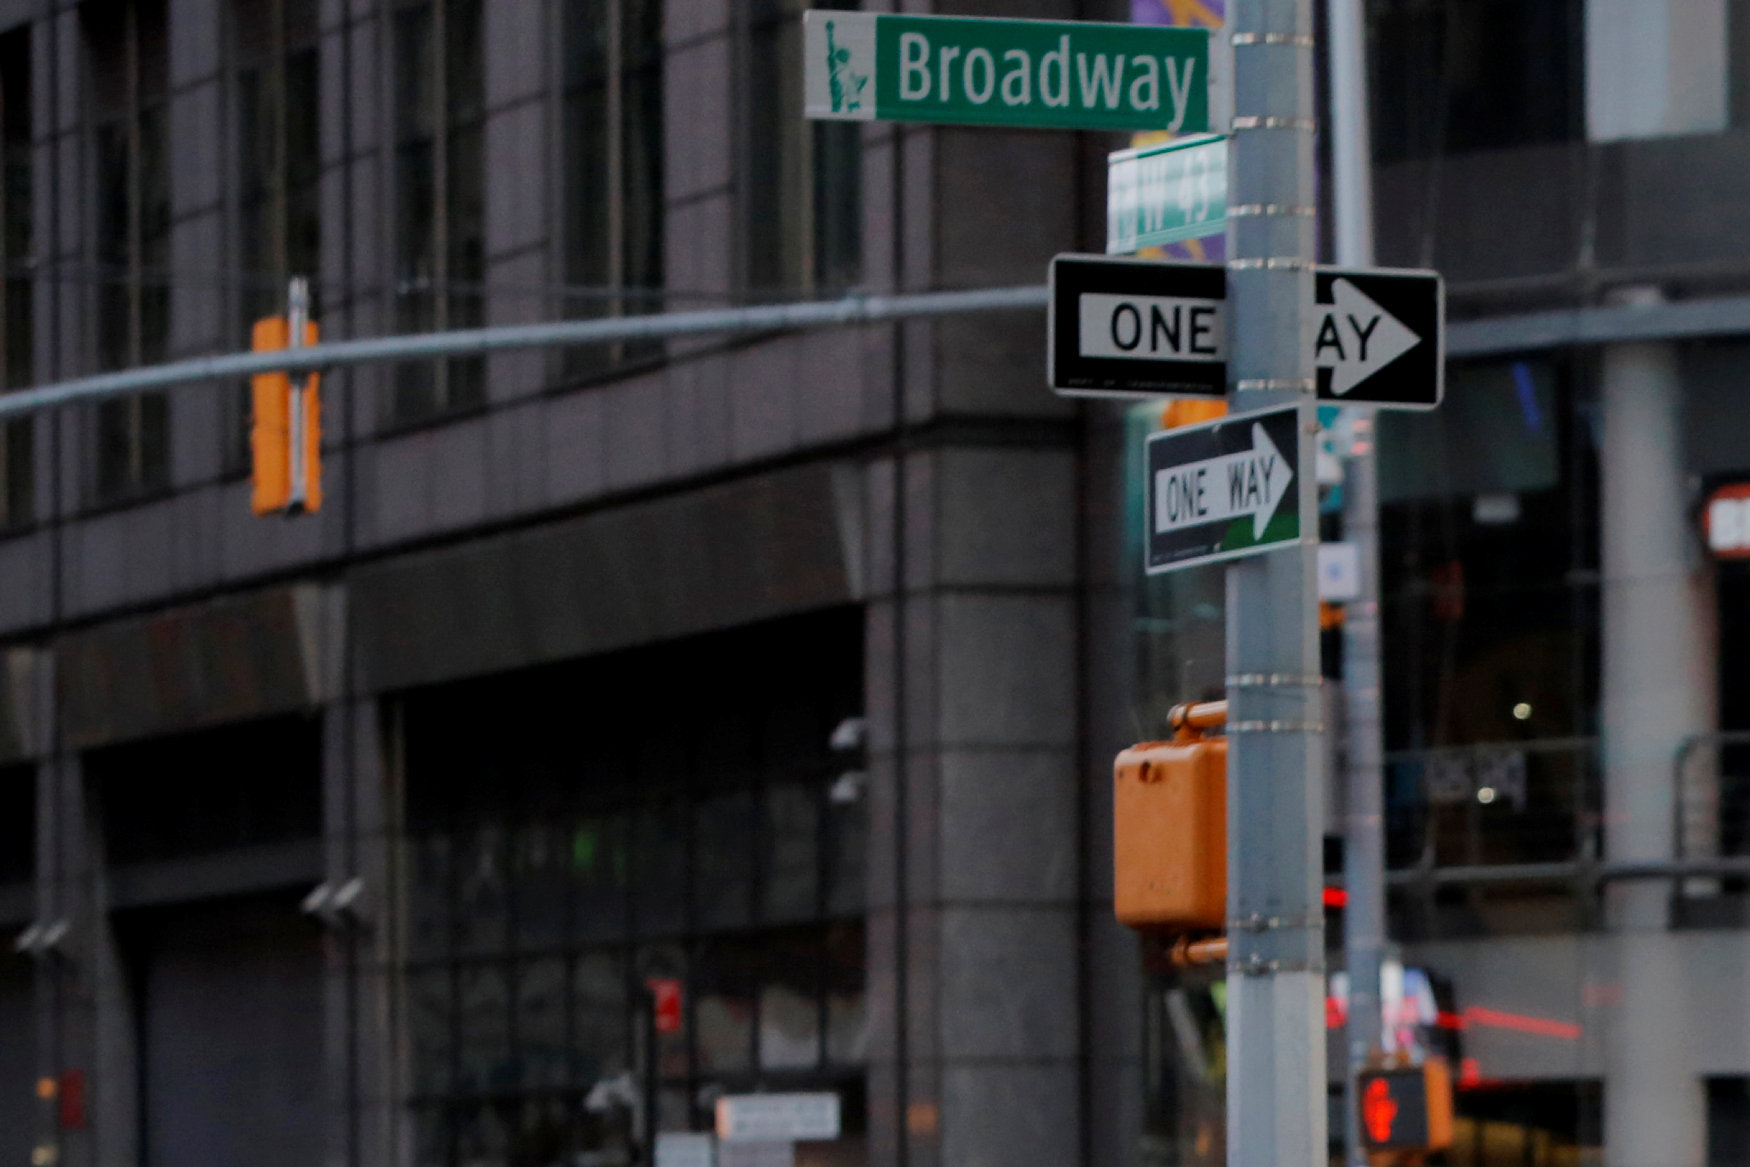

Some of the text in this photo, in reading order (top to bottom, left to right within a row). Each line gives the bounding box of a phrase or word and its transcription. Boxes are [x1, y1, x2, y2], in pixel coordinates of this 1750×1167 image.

[899, 32, 1196, 133] Broadway
[1110, 302, 1382, 362] ONE AY
[1166, 453, 1276, 525] ONE WAY
